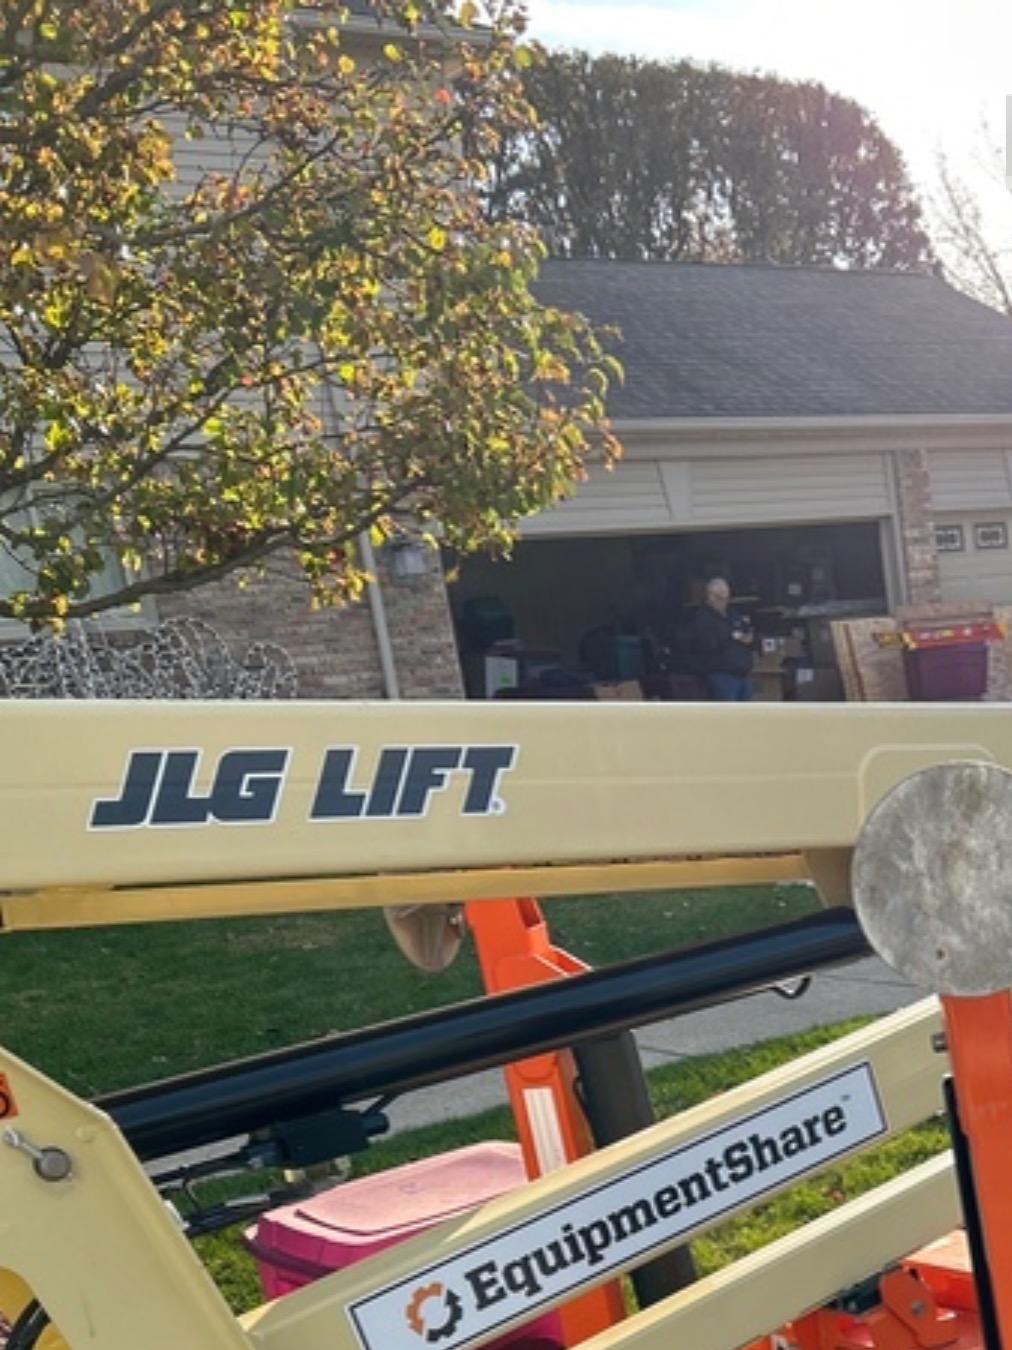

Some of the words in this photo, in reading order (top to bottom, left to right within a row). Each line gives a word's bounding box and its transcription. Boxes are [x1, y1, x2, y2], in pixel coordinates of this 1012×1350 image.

[90, 749, 291, 827] JLG
[309, 745, 512, 819] LIFT
[464, 1103, 848, 1311] EquipmentShare
